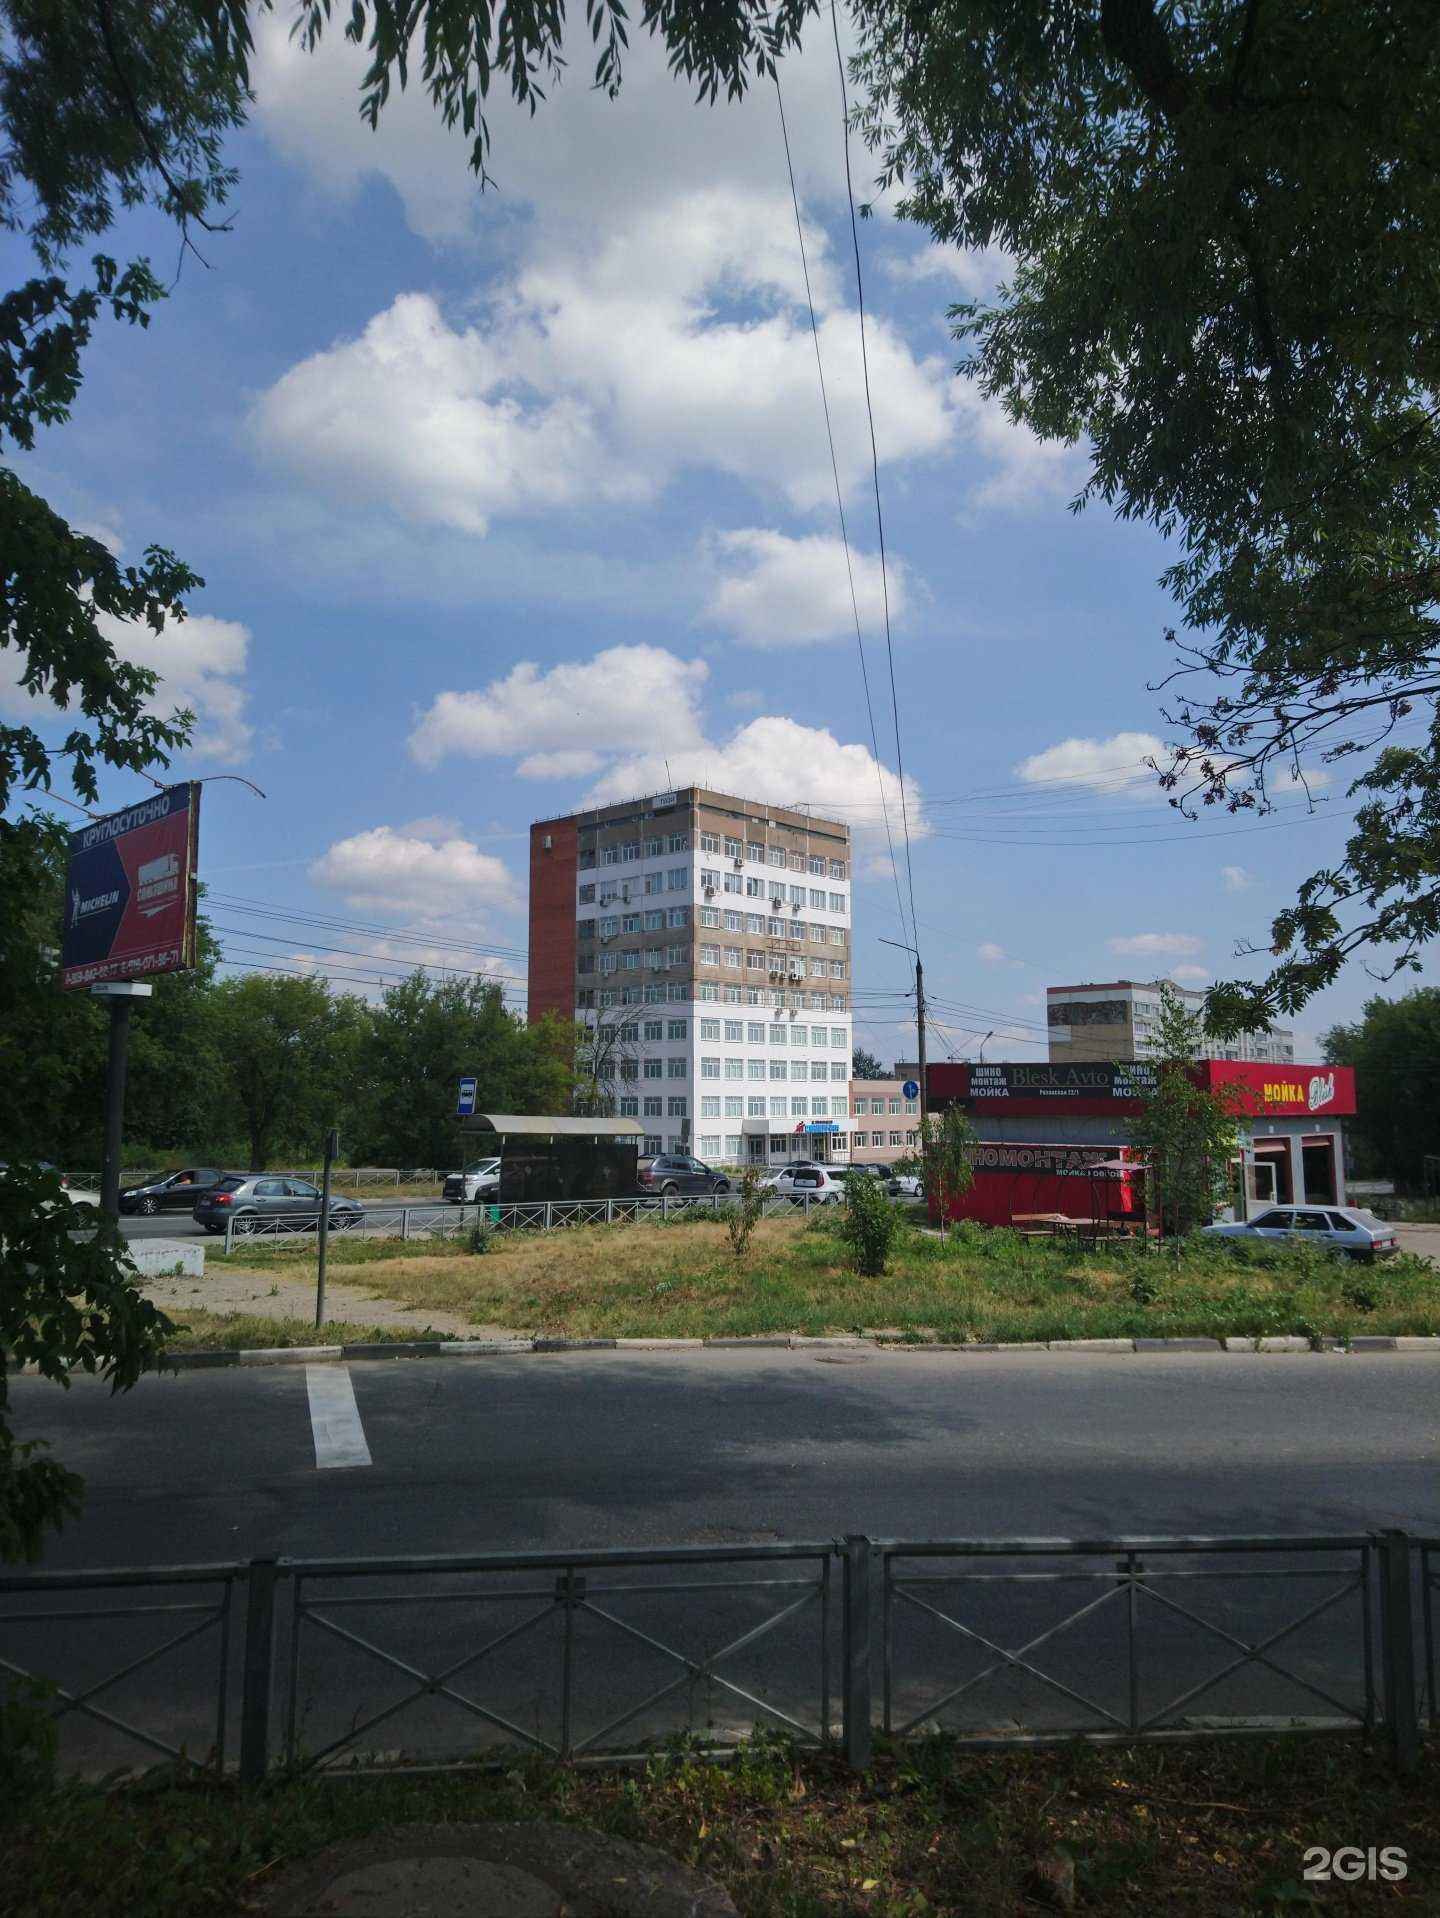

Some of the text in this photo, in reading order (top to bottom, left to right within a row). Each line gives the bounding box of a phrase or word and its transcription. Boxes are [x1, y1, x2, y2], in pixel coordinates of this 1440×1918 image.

[82, 796, 170, 849] КРУГЛОСУТОЧНО
[80, 889, 120, 914] MICHELIN
[1012, 1067, 1109, 1086] Blesk Avto
[970, 1087, 1009, 1097] МОЙКА
[1263, 1080, 1305, 1103] МОЙКА
